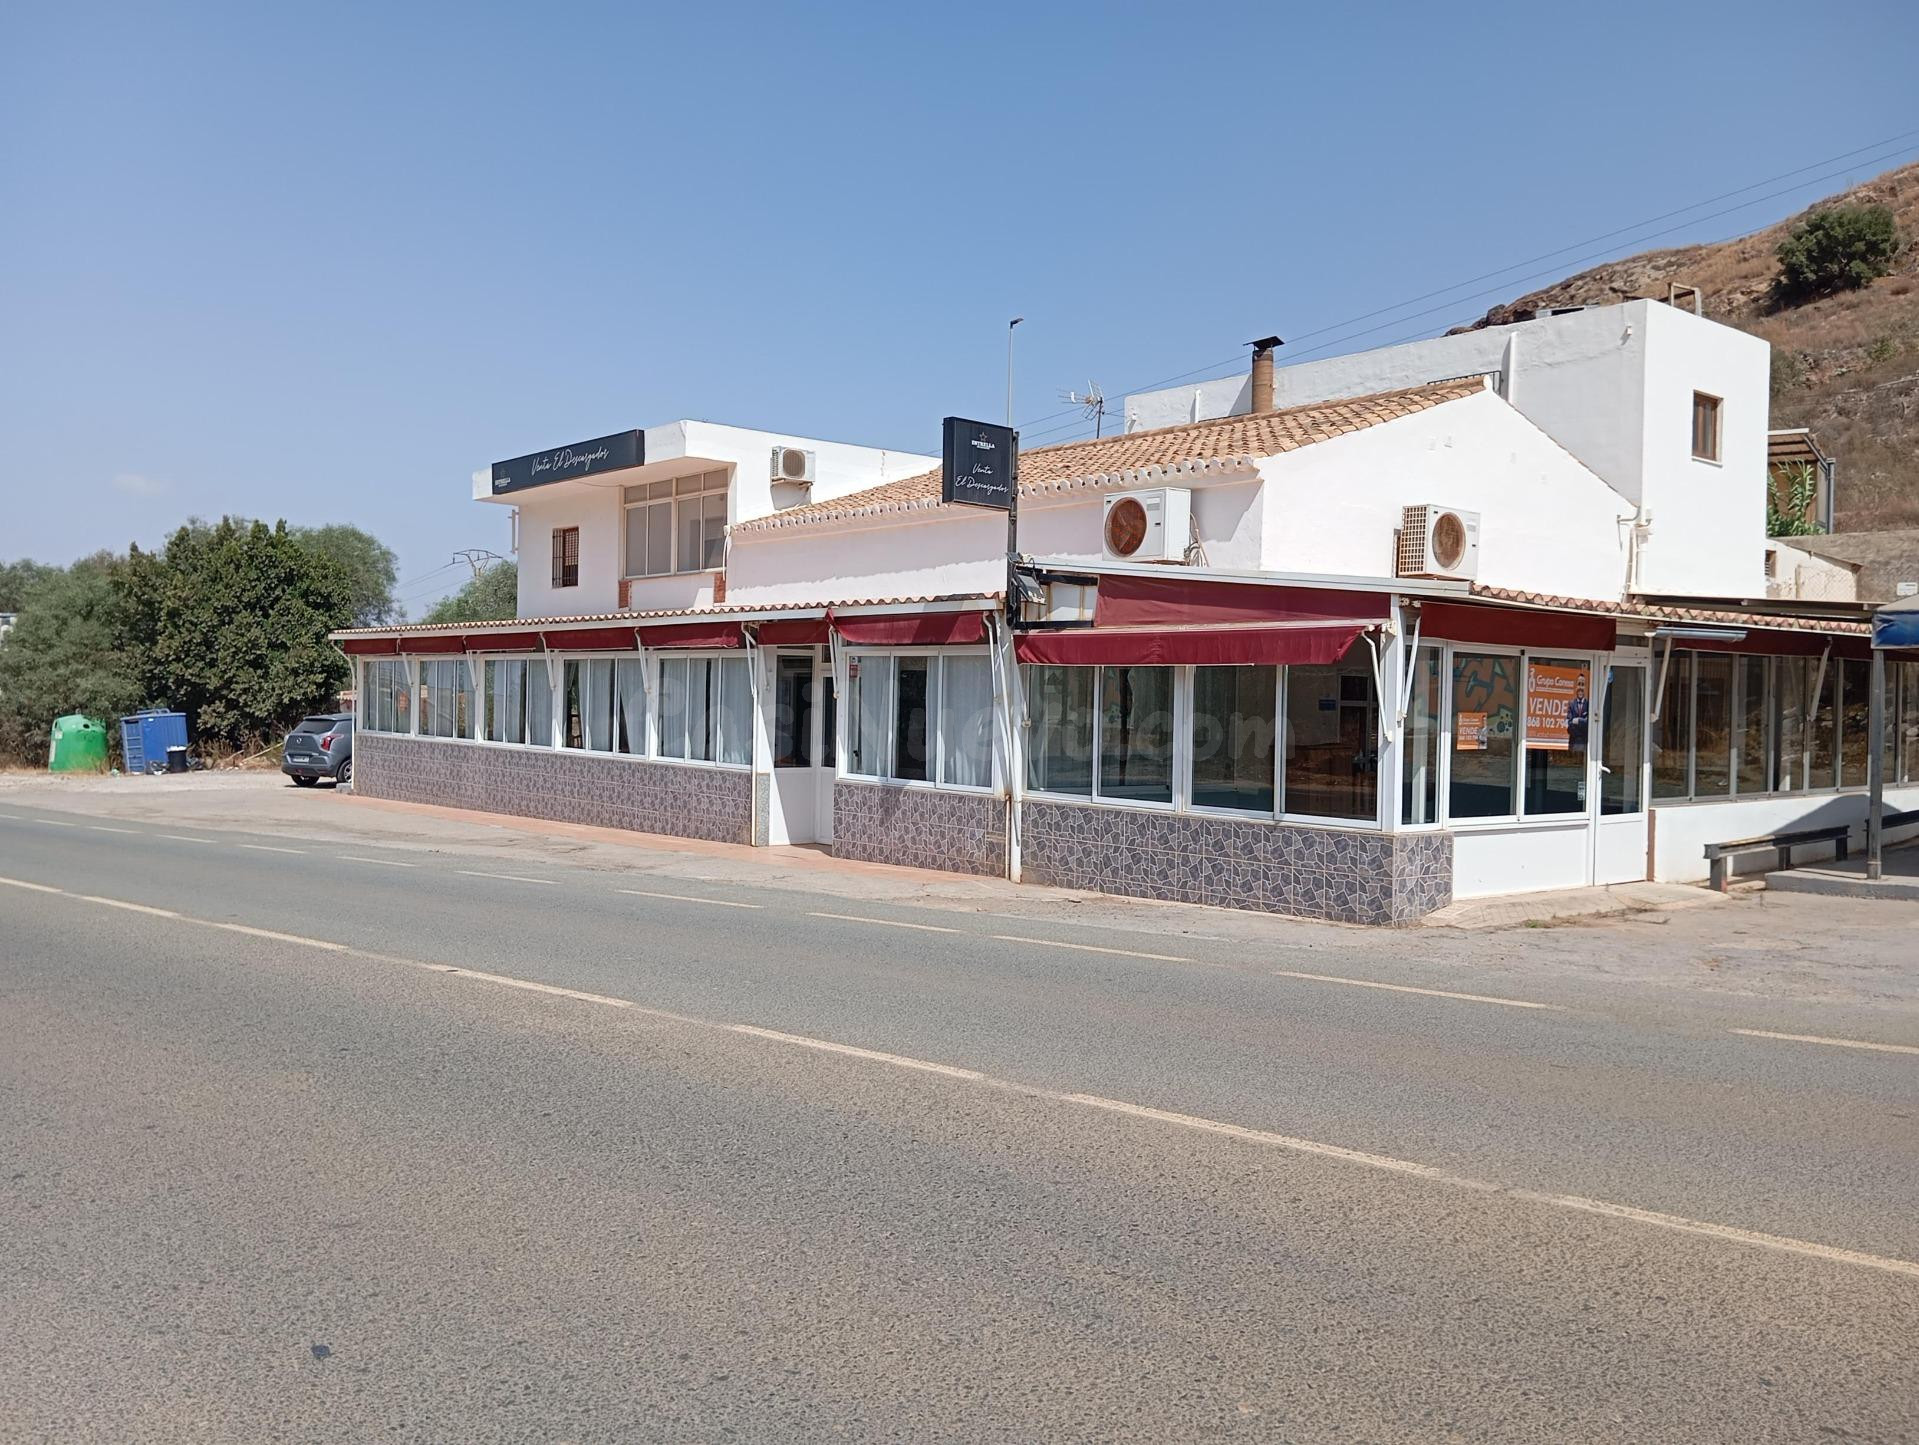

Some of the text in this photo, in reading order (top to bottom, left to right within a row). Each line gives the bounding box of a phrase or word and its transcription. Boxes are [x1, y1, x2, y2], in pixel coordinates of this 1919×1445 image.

[532, 457, 551, 476] Venta
[553, 451, 565, 471] El
[972, 463, 993, 474] Venta
[955, 475, 967, 486] El
[1529, 697, 1568, 716] VENDE
[1542, 717, 1555, 728] 102
